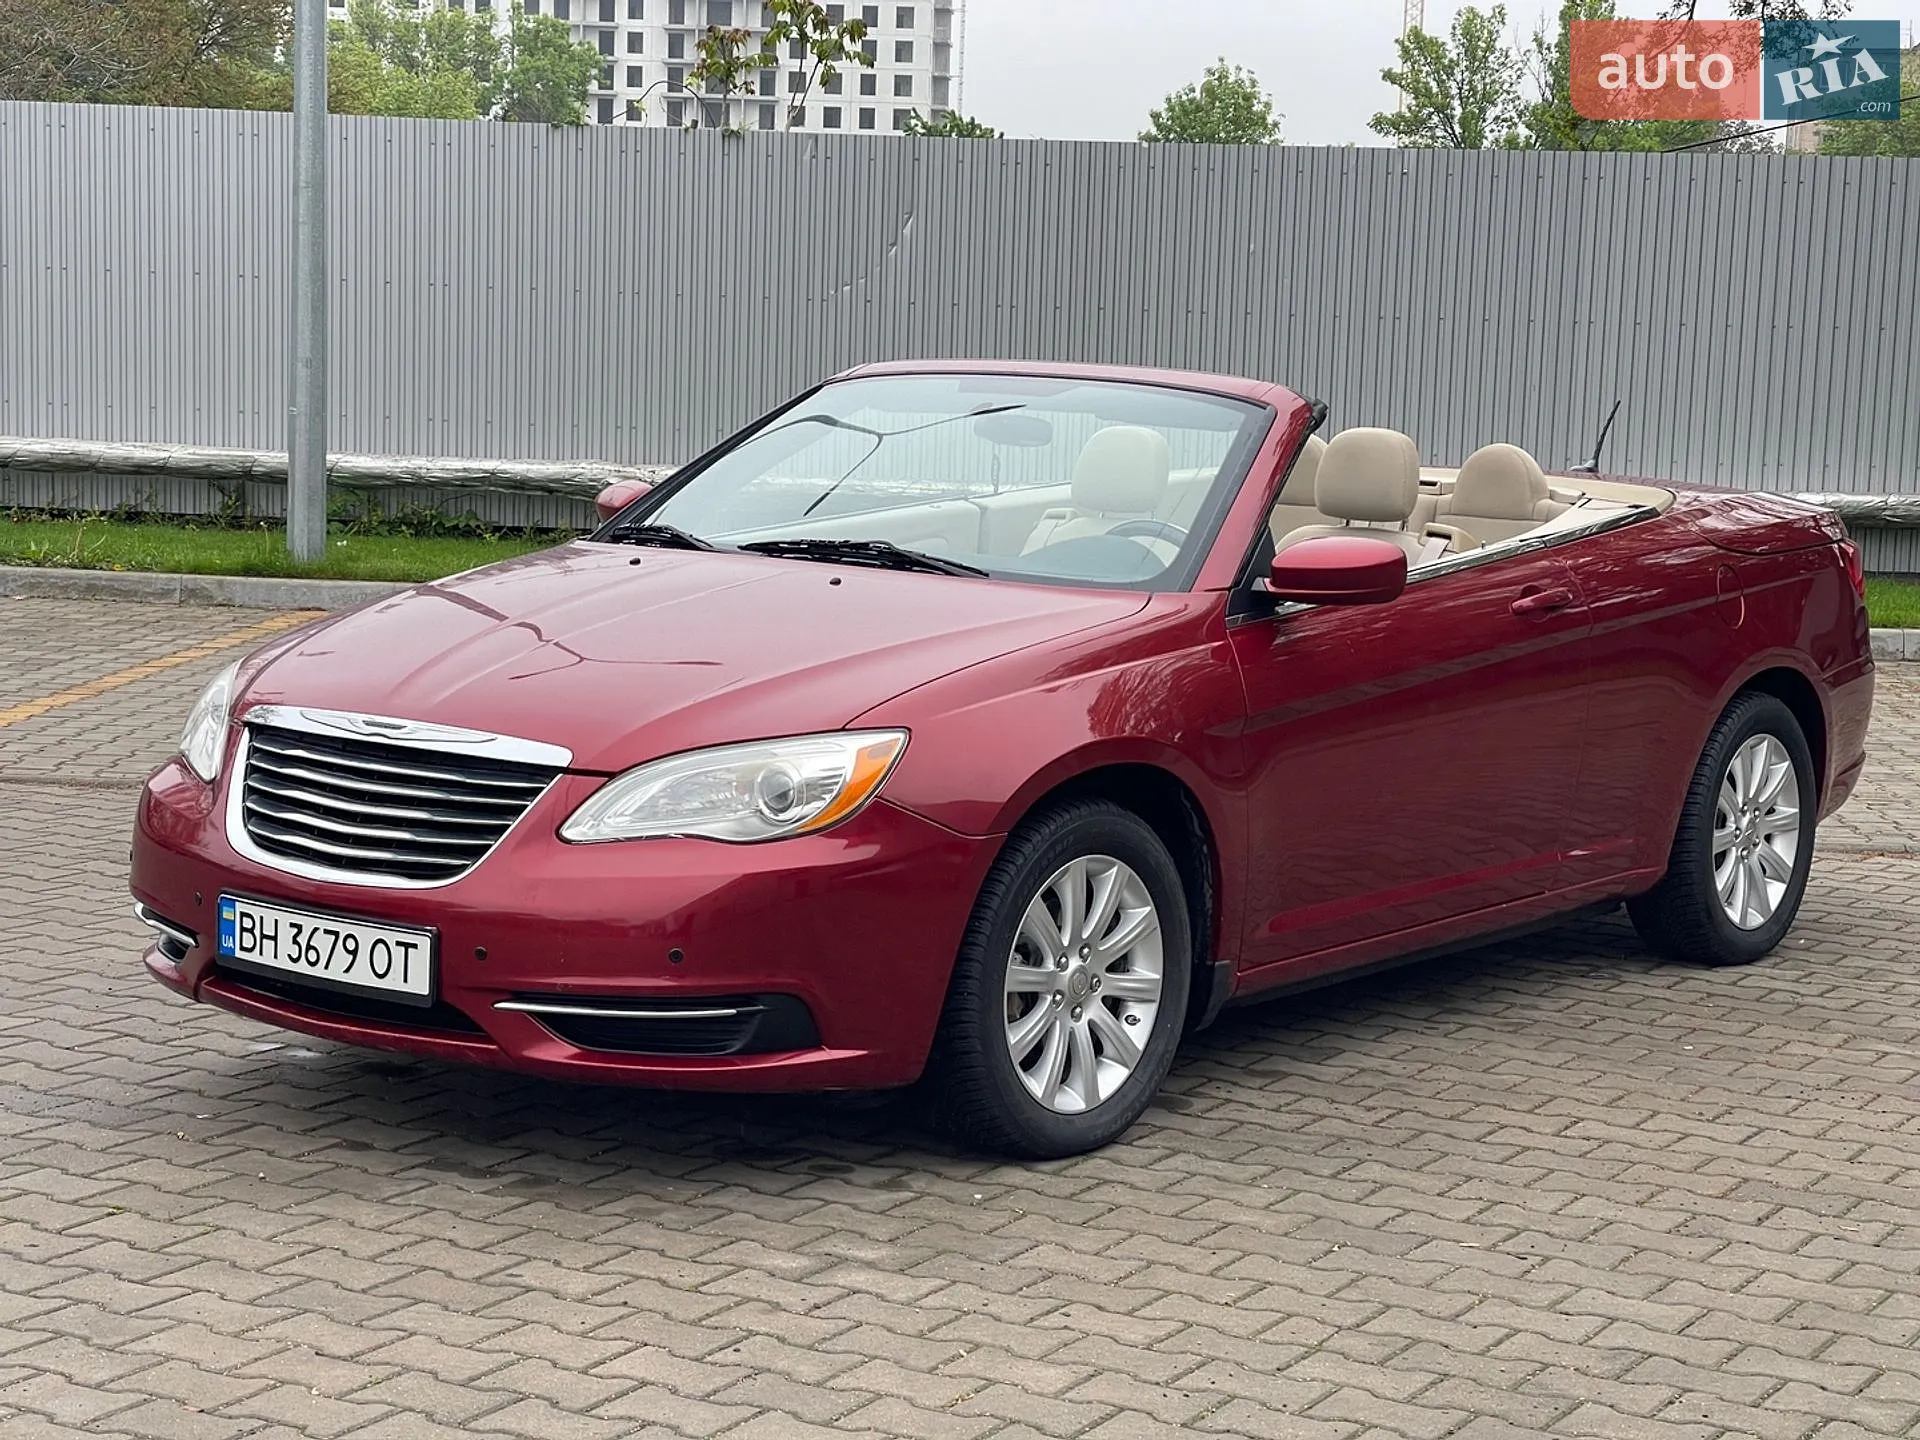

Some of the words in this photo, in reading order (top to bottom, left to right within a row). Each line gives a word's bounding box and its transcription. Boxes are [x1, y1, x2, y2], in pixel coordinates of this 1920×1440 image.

[222, 934, 234, 949] UA
[239, 911, 279, 959] BH
[287, 922, 360, 974] 3679
[369, 938, 418, 984] OT
